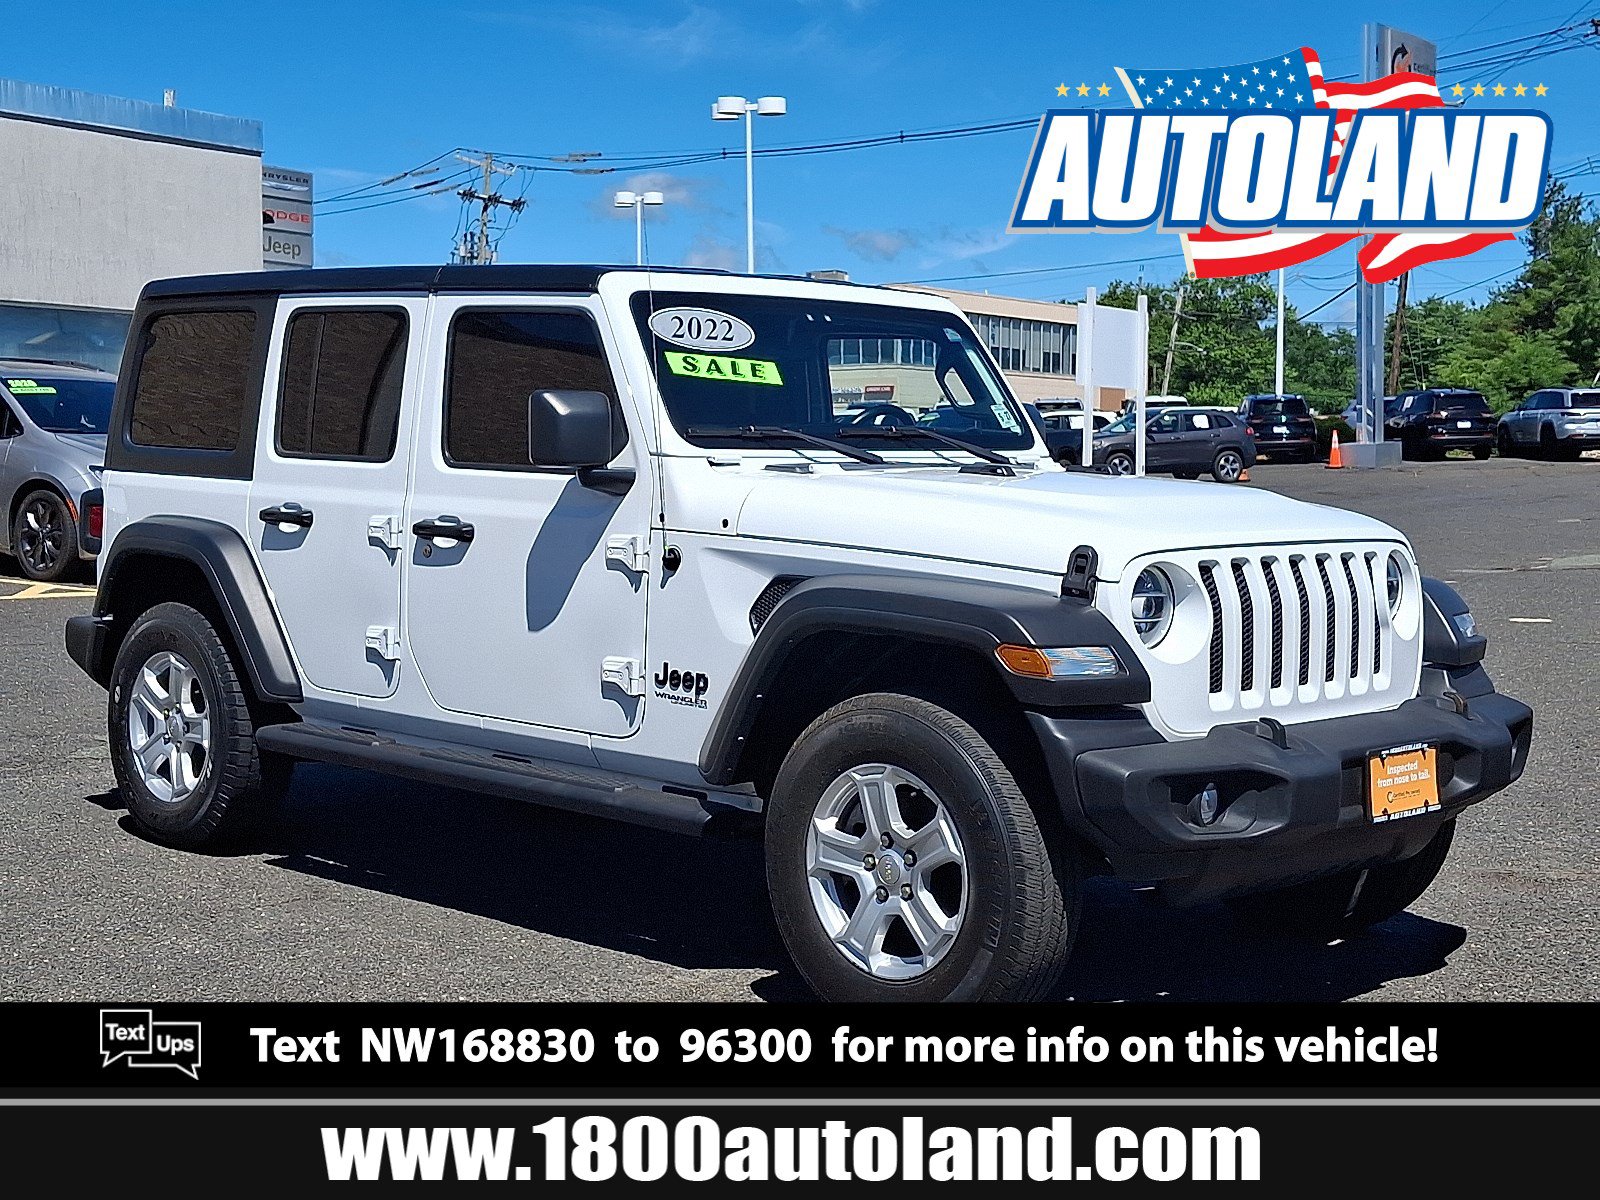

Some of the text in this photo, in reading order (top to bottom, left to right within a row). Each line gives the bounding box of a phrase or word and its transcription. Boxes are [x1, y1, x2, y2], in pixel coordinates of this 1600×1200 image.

[262, 172, 308, 184] HRYSLER
[264, 209, 310, 224] ODGE
[263, 236, 301, 259] Jeep
[671, 316, 735, 342] 2022
[682, 355, 766, 381] SALE
[654, 661, 708, 699] Jeep
[654, 690, 707, 706] WRANGLER
[1387, 760, 1418, 775] Inspected
[1377, 777, 1393, 788] from
[1394, 774, 1410, 784] nose
[1410, 772, 1418, 782] to
